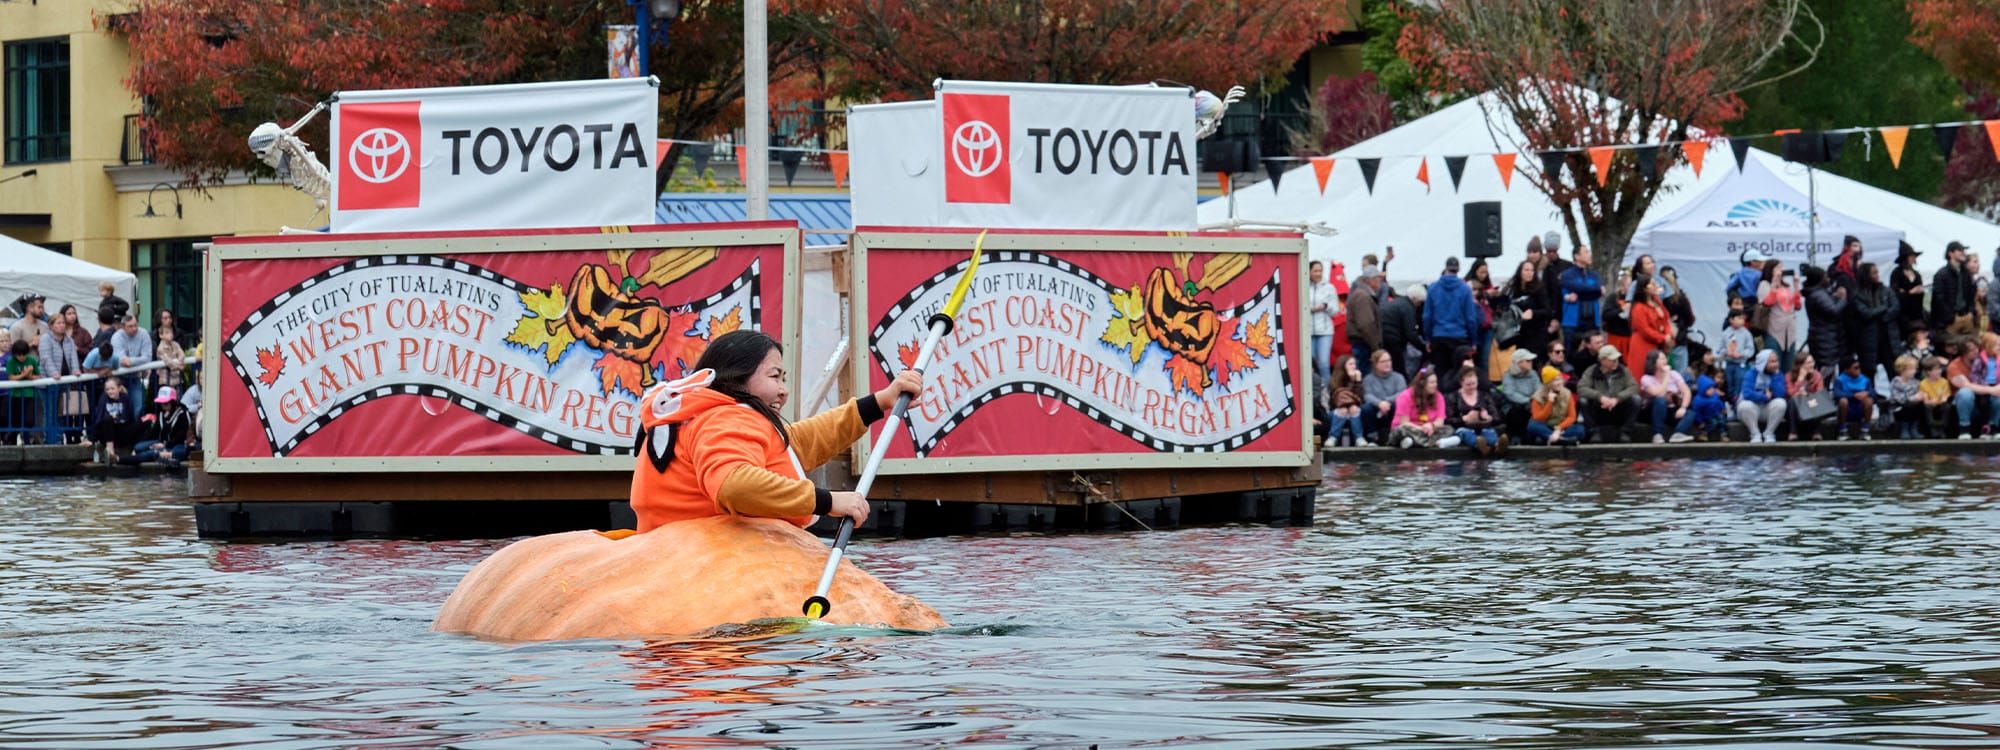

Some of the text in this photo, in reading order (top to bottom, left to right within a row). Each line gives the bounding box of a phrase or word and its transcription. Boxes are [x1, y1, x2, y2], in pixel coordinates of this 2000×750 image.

[442, 122, 648, 175] TOYOTA
[1027, 127, 1189, 176] TOYOTA
[273, 275, 502, 337] THE CITY OF TUALATIN'S
[983, 273, 1001, 294] OF
[1005, 272, 1096, 312] TUALATIN'S
[1005, 295, 1091, 341] COAST
[288, 297, 495, 367] WEST COAST
[279, 339, 388, 425] GIANT
[398, 337, 559, 415] PUMPKIN
[919, 335, 1272, 436] GIANT PUMPKIN REGATTA
